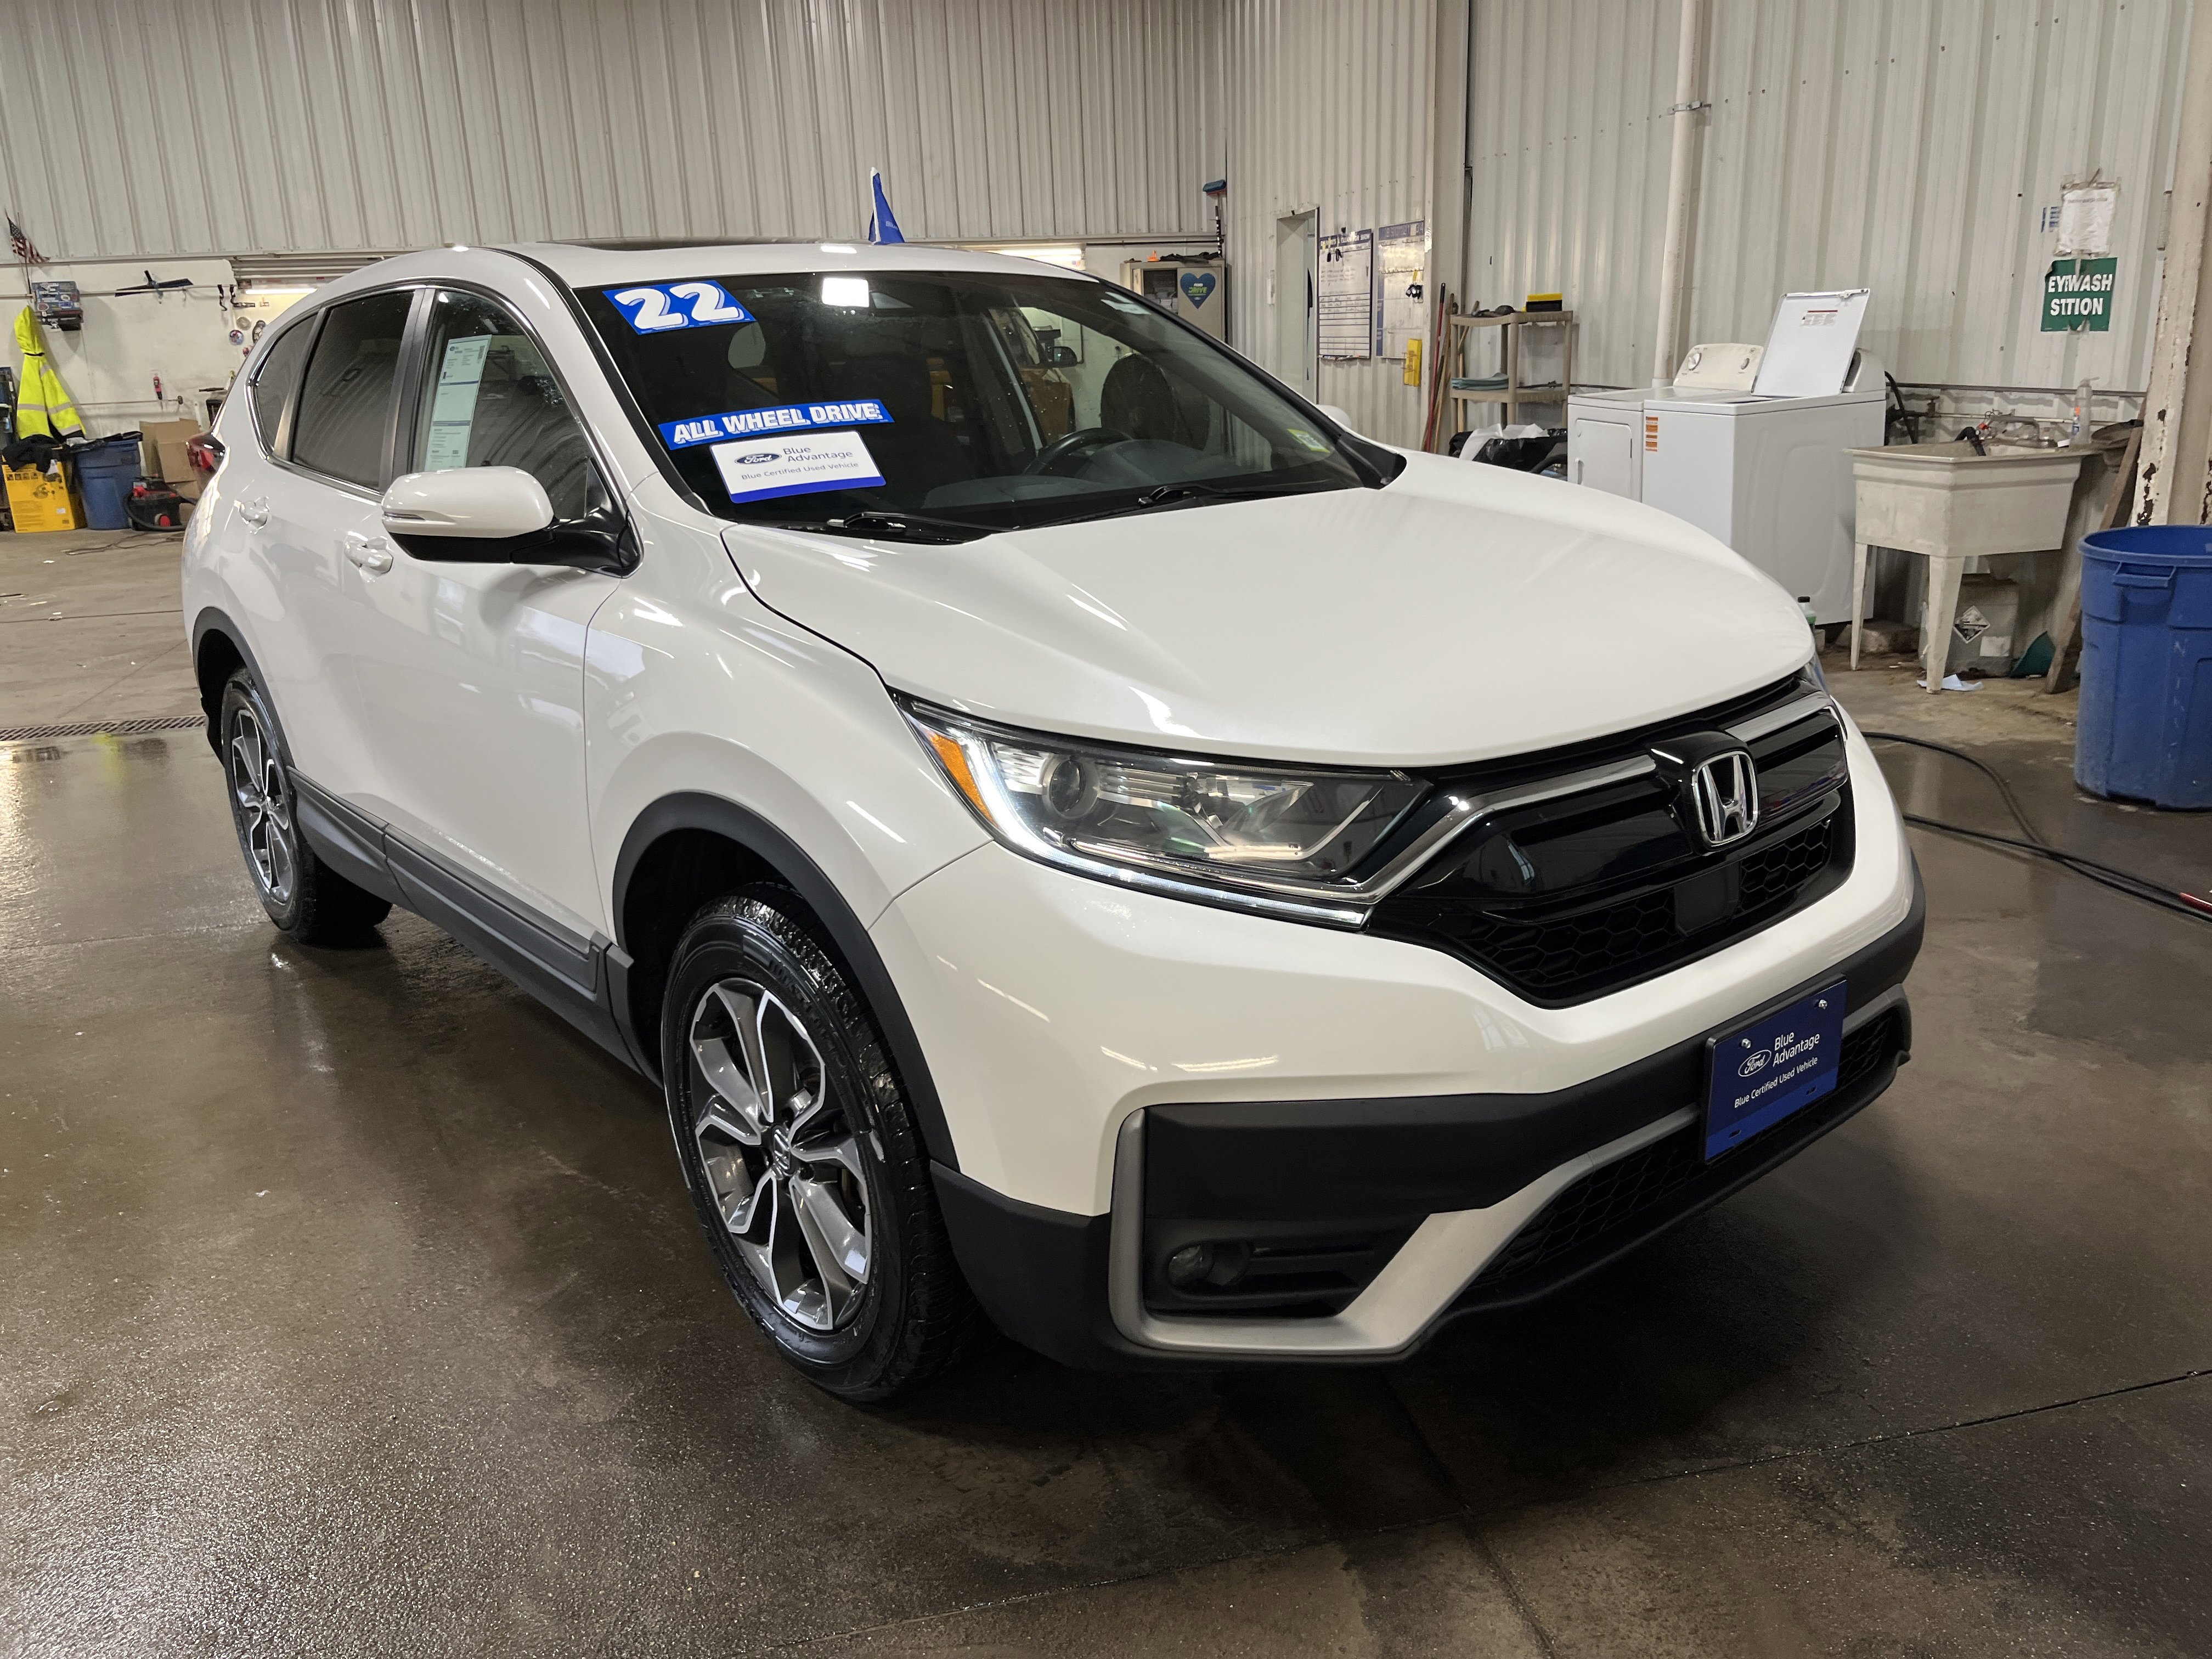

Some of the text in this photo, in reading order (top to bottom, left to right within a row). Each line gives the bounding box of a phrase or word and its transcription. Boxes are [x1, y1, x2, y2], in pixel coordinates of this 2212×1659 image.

[614, 283, 744, 330] 22
[2050, 297, 2103, 316] STTION
[674, 403, 883, 444] ALL WHEEL DRIVE
[787, 451, 853, 462] Advantage
[764, 467, 802, 476] Certified
[1773, 1034, 1820, 1068] Advantage
[1774, 1032, 1795, 1051] Blue
[1734, 1057, 1819, 1108] Blue Certified Used Vehicle
